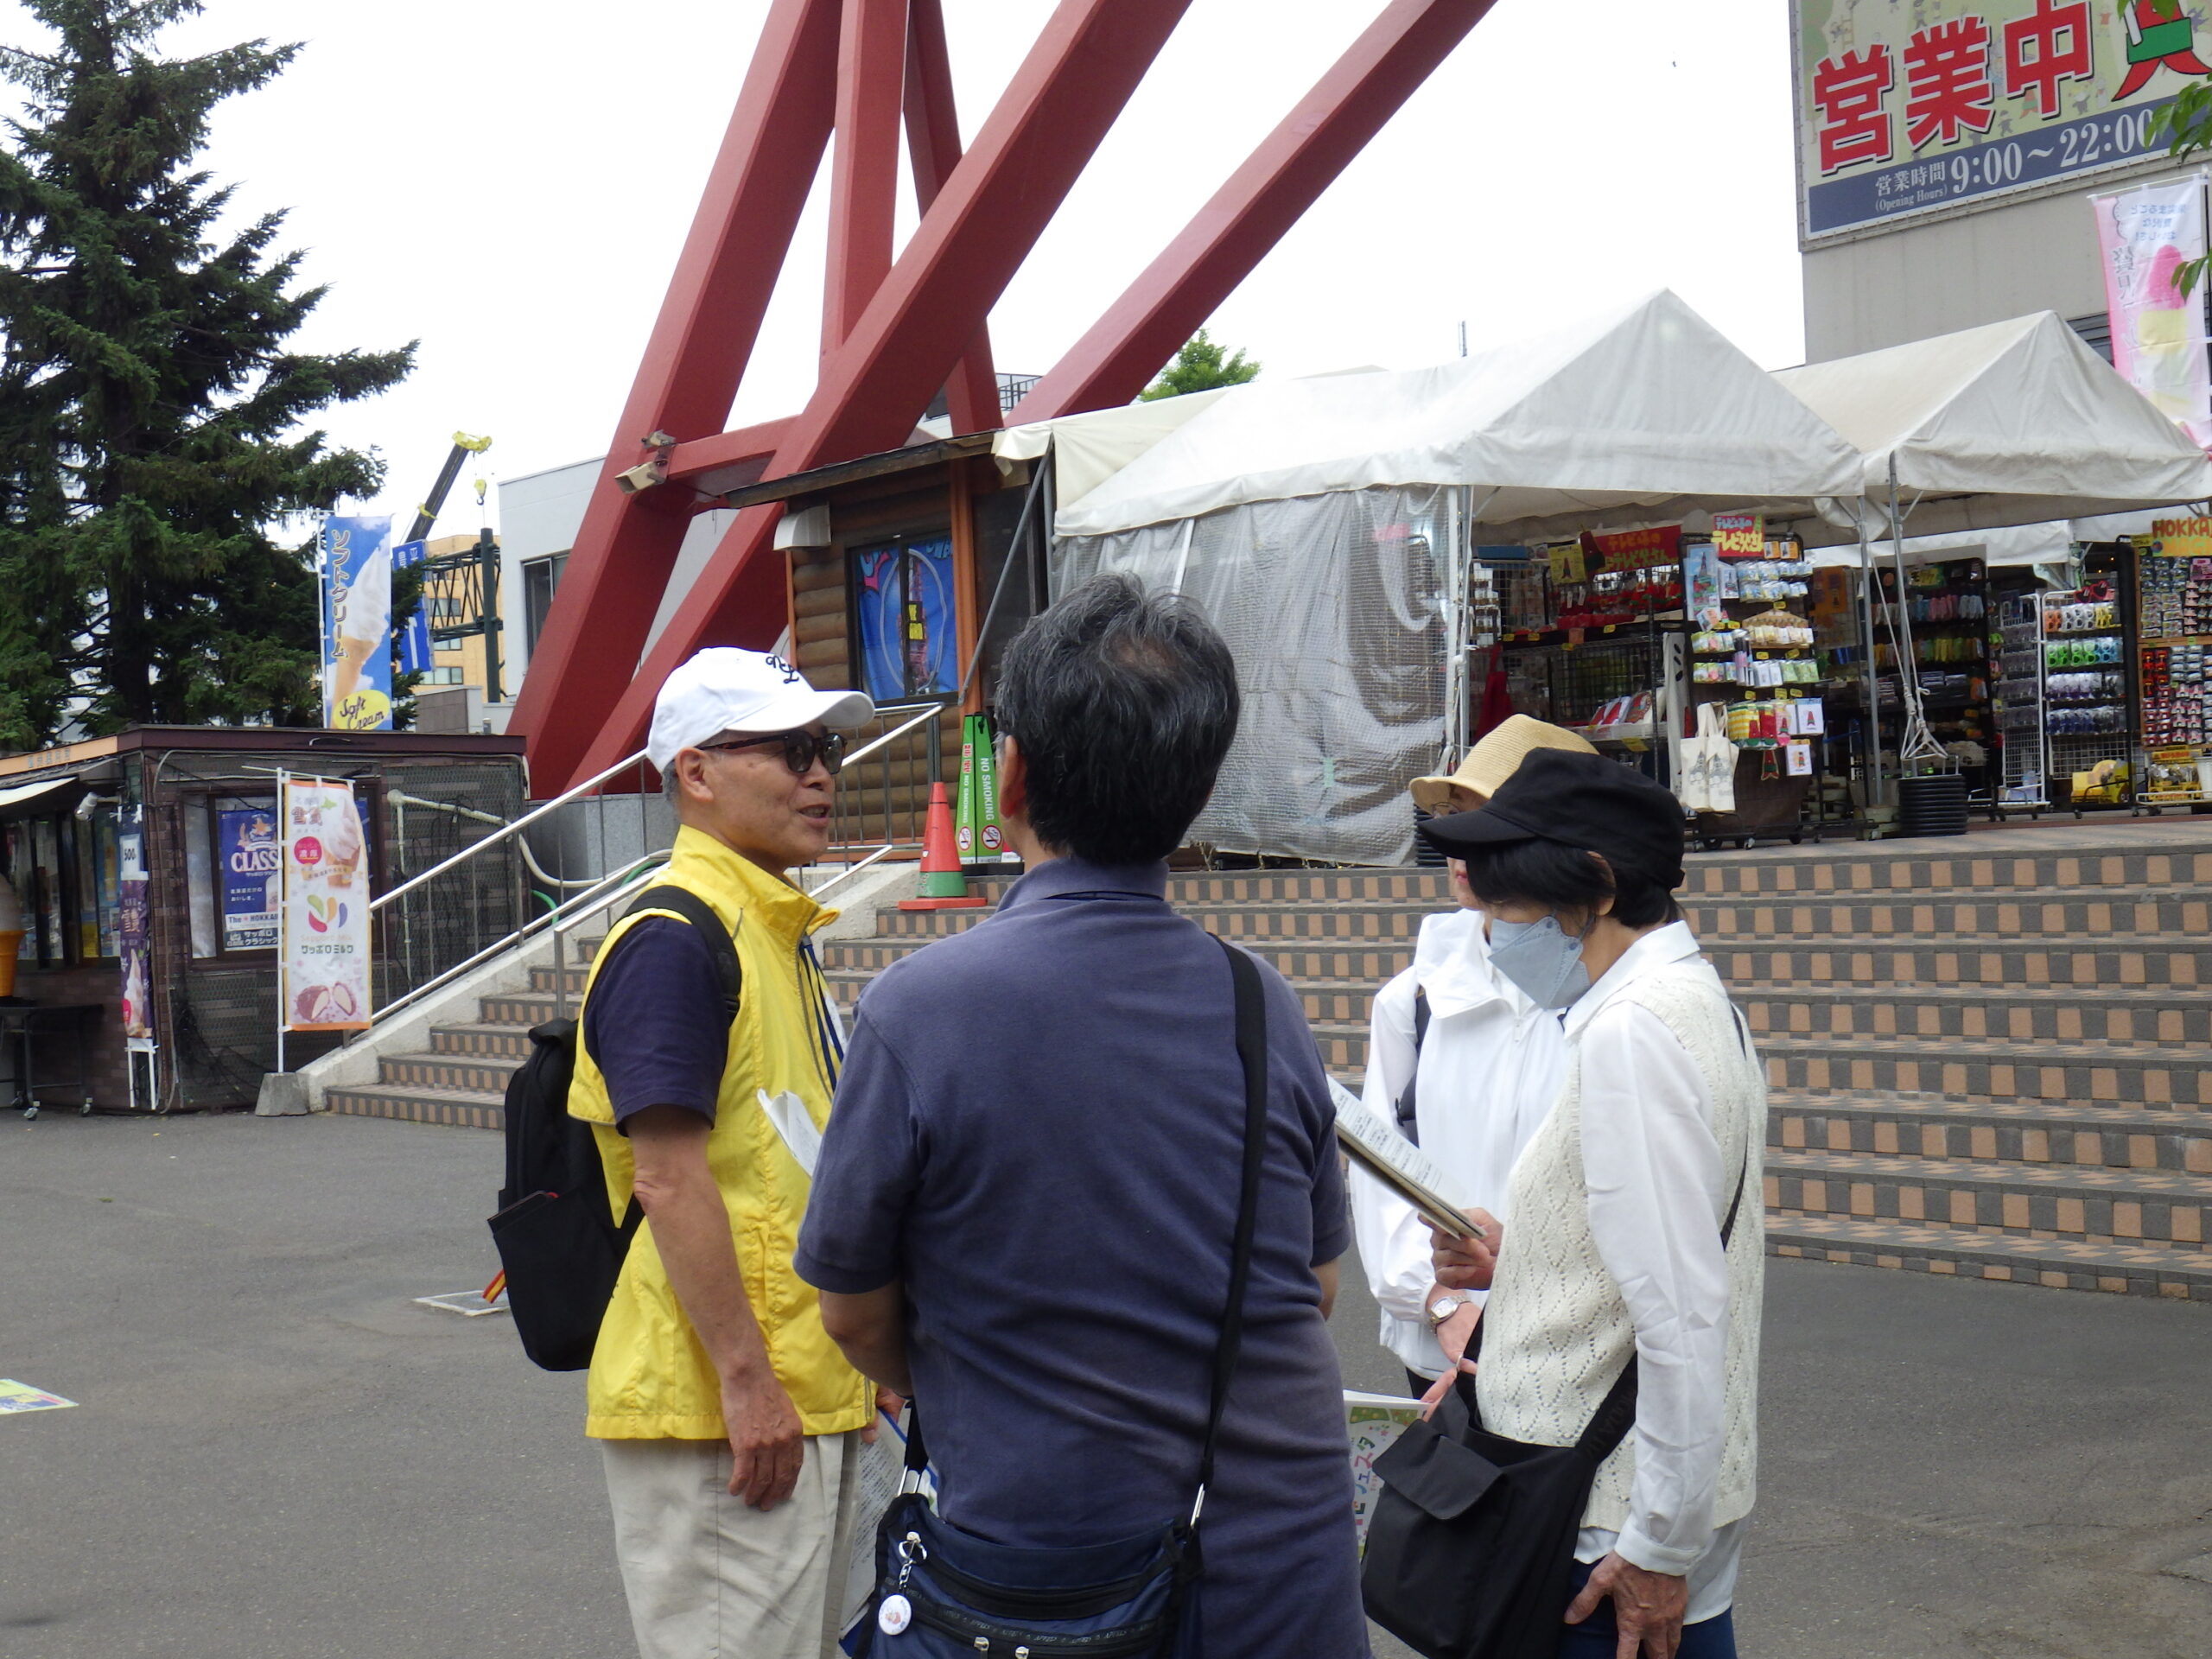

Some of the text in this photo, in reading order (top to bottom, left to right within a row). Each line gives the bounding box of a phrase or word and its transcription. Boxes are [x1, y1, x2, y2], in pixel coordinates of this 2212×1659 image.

[1813, 0, 2093, 173] 営業中
[1875, 162, 1946, 197] 営業時間
[1875, 184, 1948, 212] (Opening Hours)
[331, 529, 351, 659] ソフトクリーム
[340, 695, 366, 719] Soft
[347, 711, 385, 730] Cream
[980, 758, 995, 821] NO SMOKING
